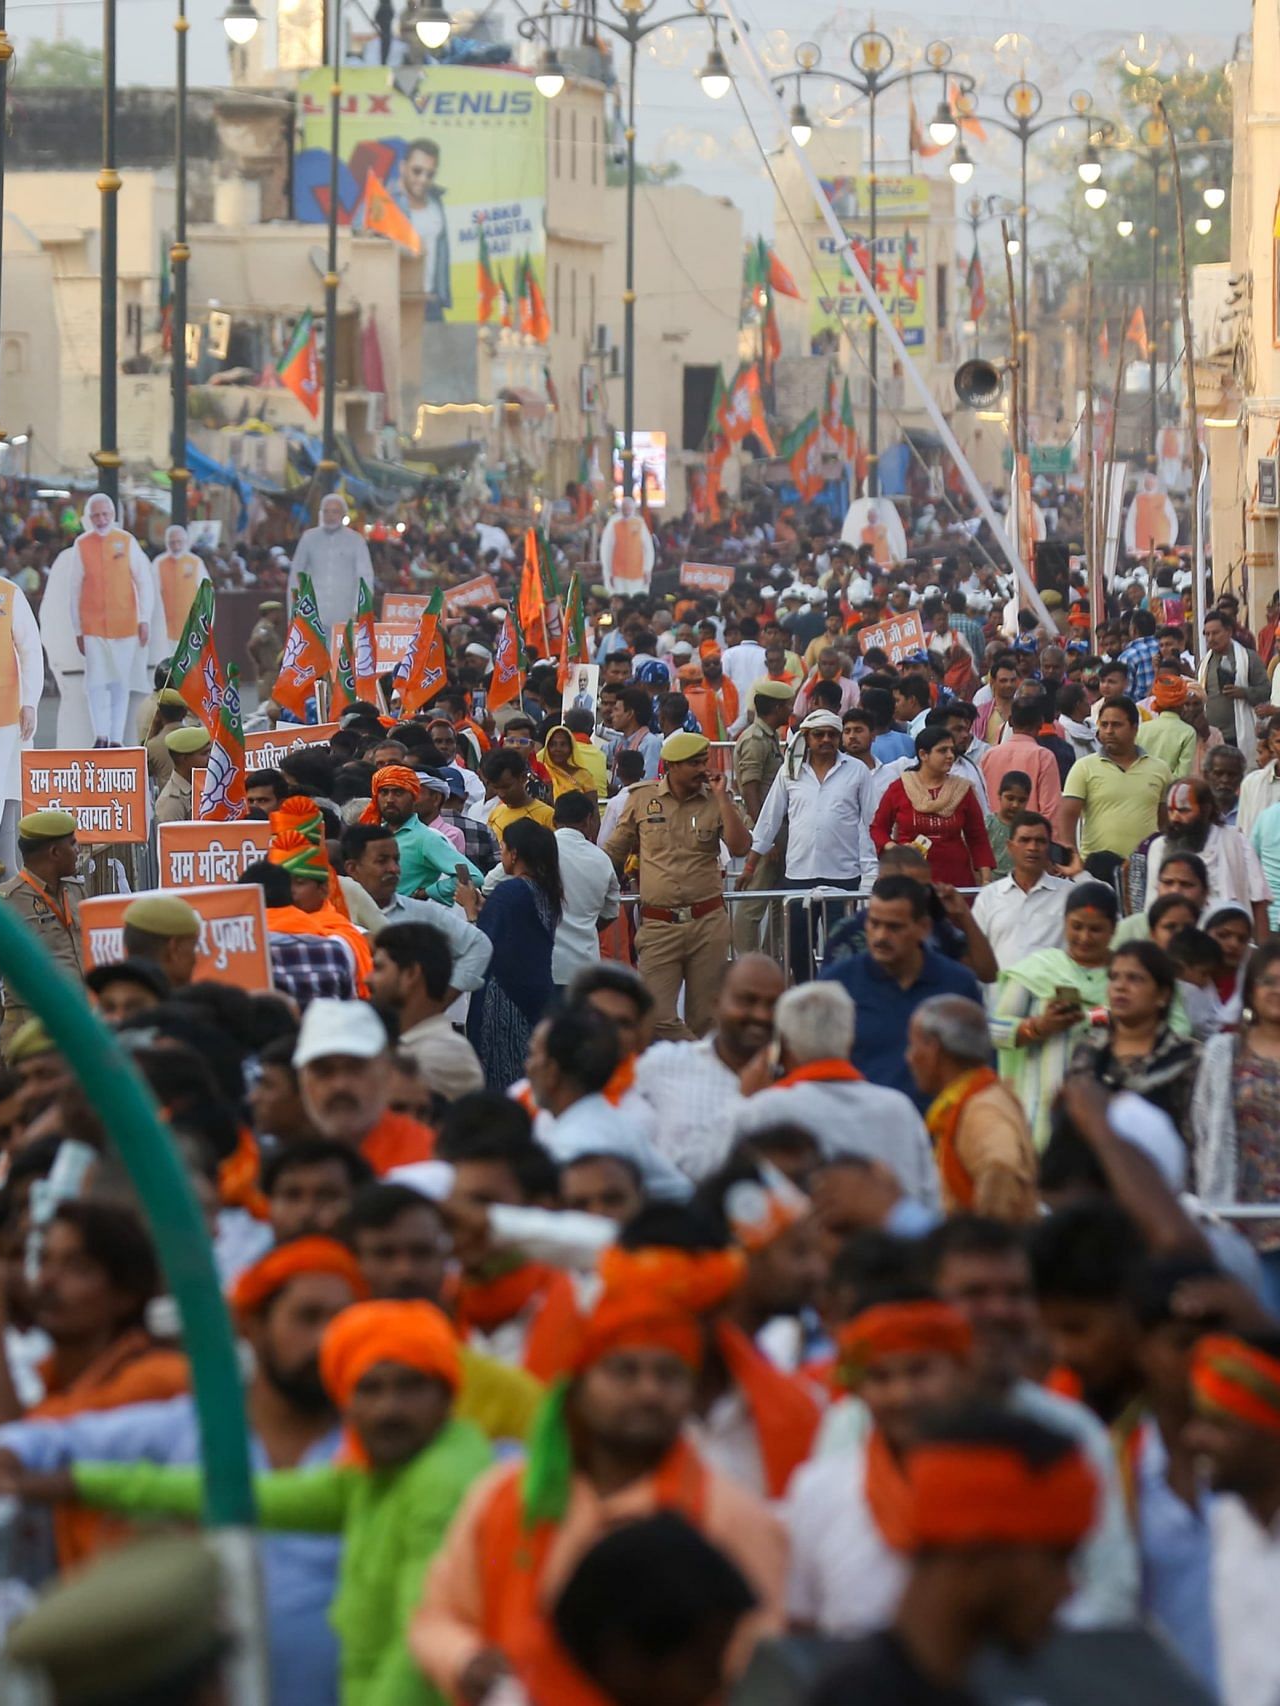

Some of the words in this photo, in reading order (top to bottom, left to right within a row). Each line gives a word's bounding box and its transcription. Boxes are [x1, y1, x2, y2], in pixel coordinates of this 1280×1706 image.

[303, 95, 391, 114] LUX
[411, 91, 534, 115] VENUS
[29, 769, 51, 795] राम
[52, 761, 81, 795] नगरी
[84, 761, 96, 795] में
[96, 768, 137, 795] आपका
[76, 806, 112, 832] स्वागत
[169, 852, 195, 884] राम
[198, 841, 240, 883] मन्दिर
[210, 915, 258, 971] पुकार
